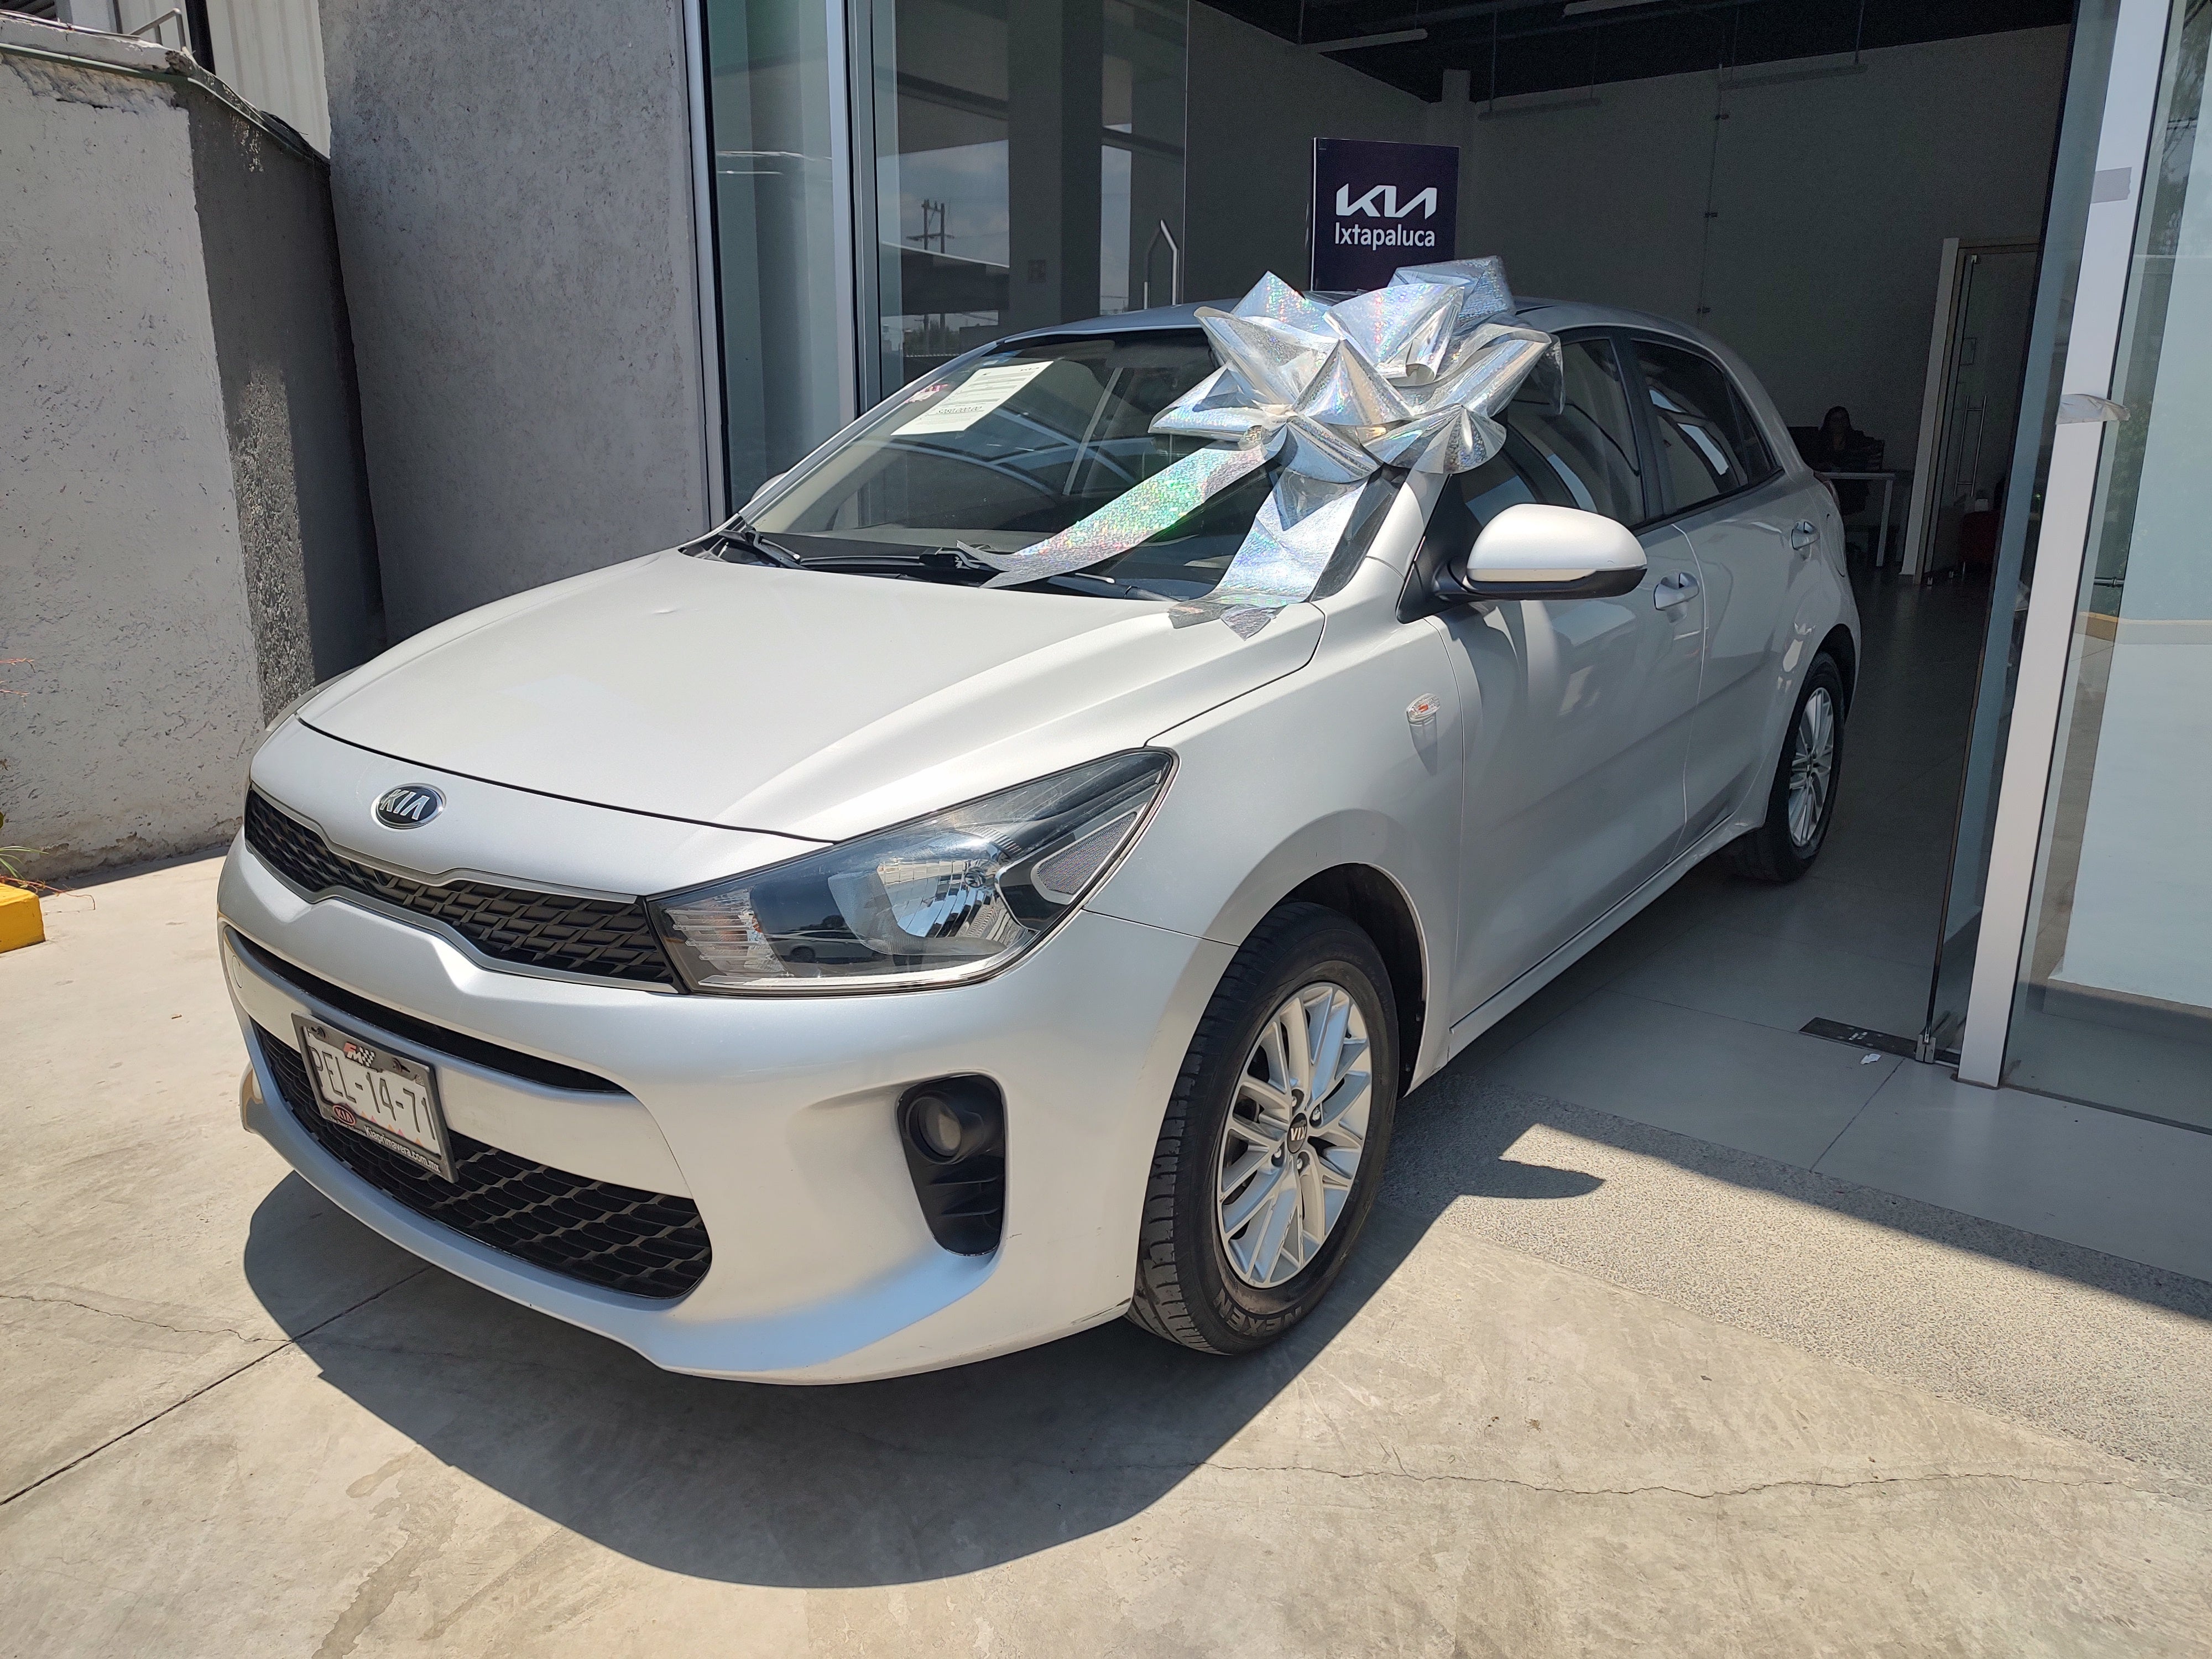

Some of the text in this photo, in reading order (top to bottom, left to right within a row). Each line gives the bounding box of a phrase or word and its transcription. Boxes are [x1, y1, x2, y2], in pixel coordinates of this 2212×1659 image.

[1336, 183, 1437, 220] KIA
[1335, 222, 1435, 251] Ixtapaluca
[380, 789, 430, 820] KIA
[310, 1046, 436, 1140] PEL-14-71
[364, 1125, 441, 1173] Kiaprimavera.com.mx
[1213, 1288, 1302, 1336] NEXEN
